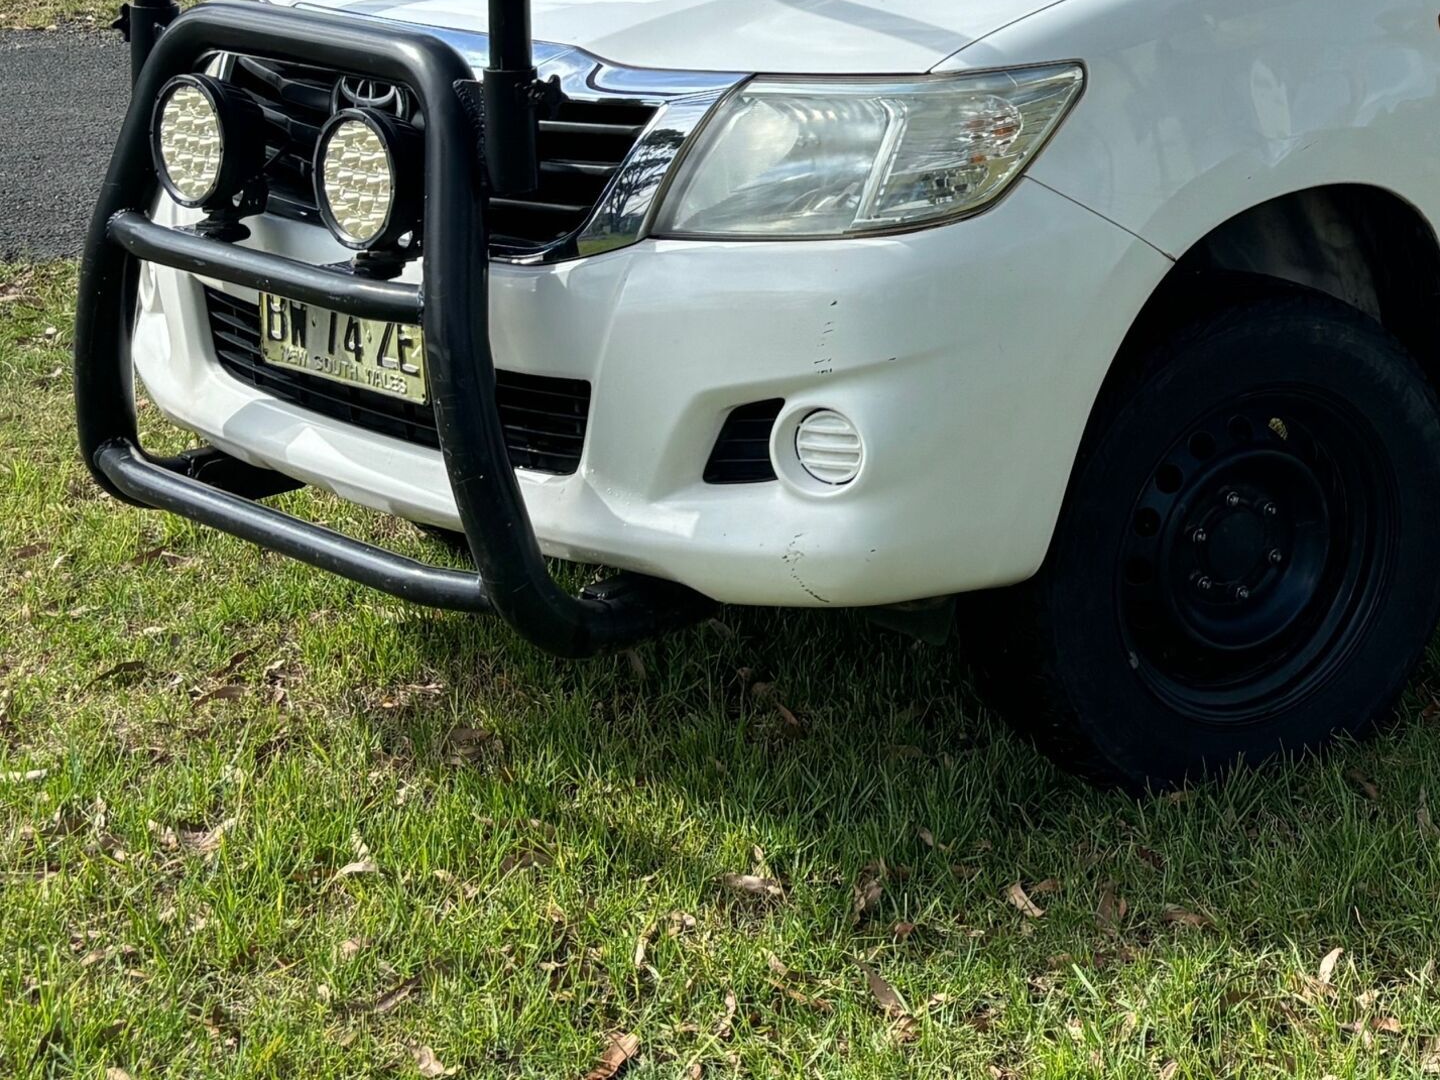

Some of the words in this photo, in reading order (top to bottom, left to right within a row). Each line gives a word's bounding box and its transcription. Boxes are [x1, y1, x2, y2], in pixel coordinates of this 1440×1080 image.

[282, 344, 308, 367] NEW
[313, 356, 359, 381] SOUTH
[365, 366, 408, 395] WALES
